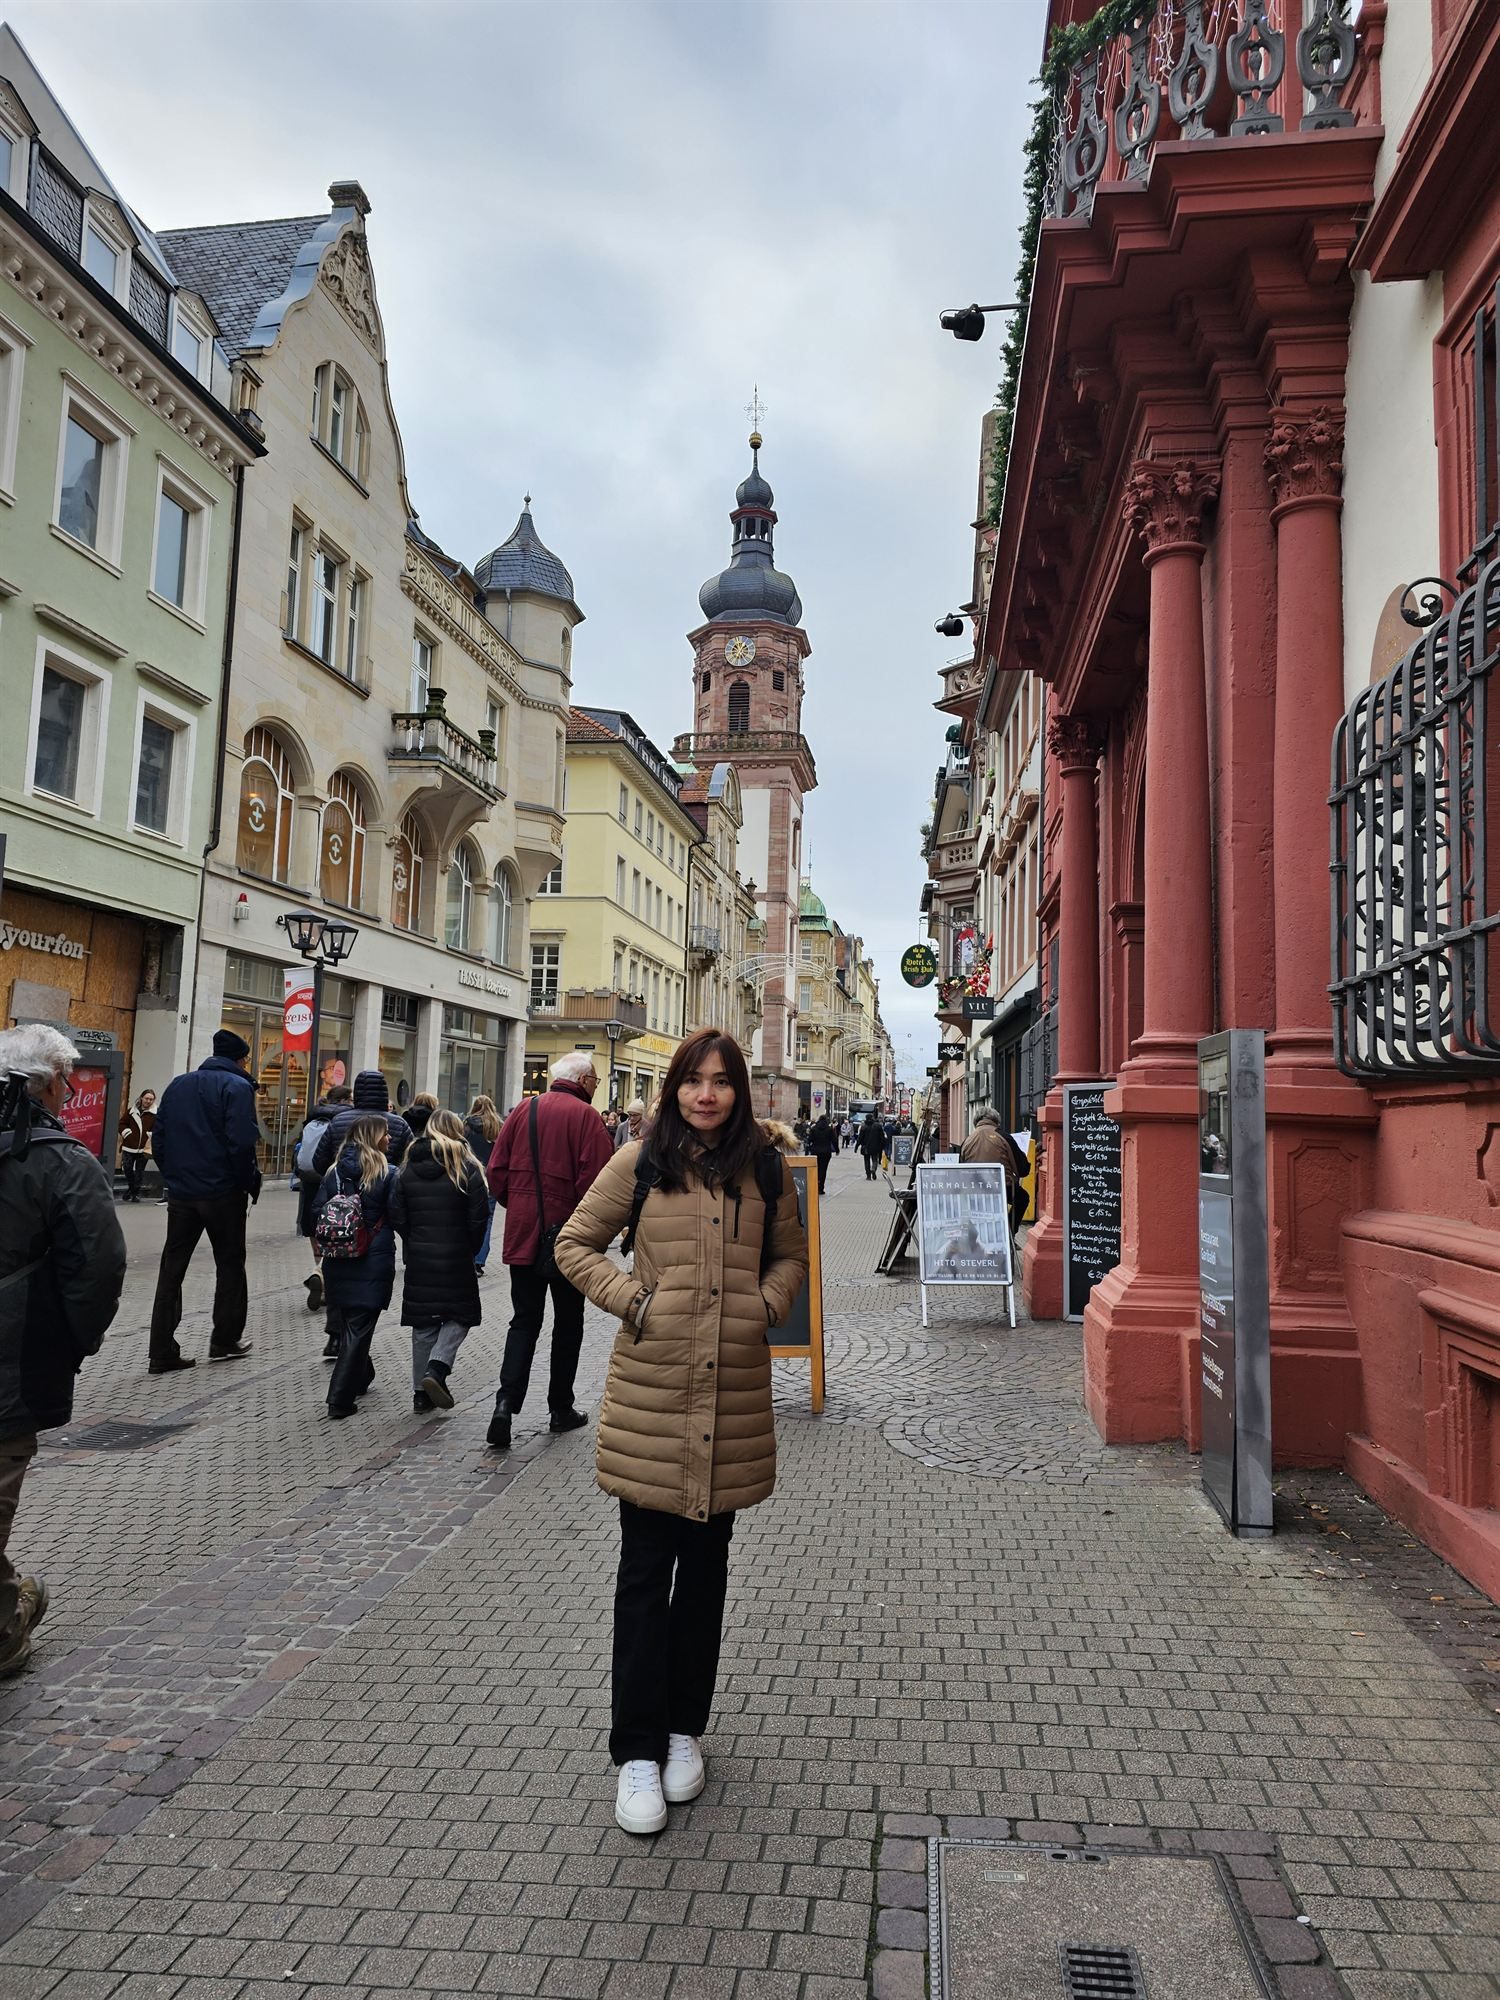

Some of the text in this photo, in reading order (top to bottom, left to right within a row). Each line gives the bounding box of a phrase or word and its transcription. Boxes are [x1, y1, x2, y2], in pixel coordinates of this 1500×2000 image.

[969, 1002, 988, 1010] VIU
[283, 1012, 314, 1027] geist
[63, 1084, 106, 1110] der!
[1200, 1228, 1219, 1247] Restaurant
[934, 1259, 999, 1267] HITO STEYERL
[1201, 1247, 1217, 1265] Garibaldi
[1202, 1290, 1226, 1316] Kurpfälzisches
[1202, 1308, 1216, 1329] Museum
[1202, 1351, 1225, 1382] Heidelberger
[1202, 1370, 1223, 1400] Kunstverein
